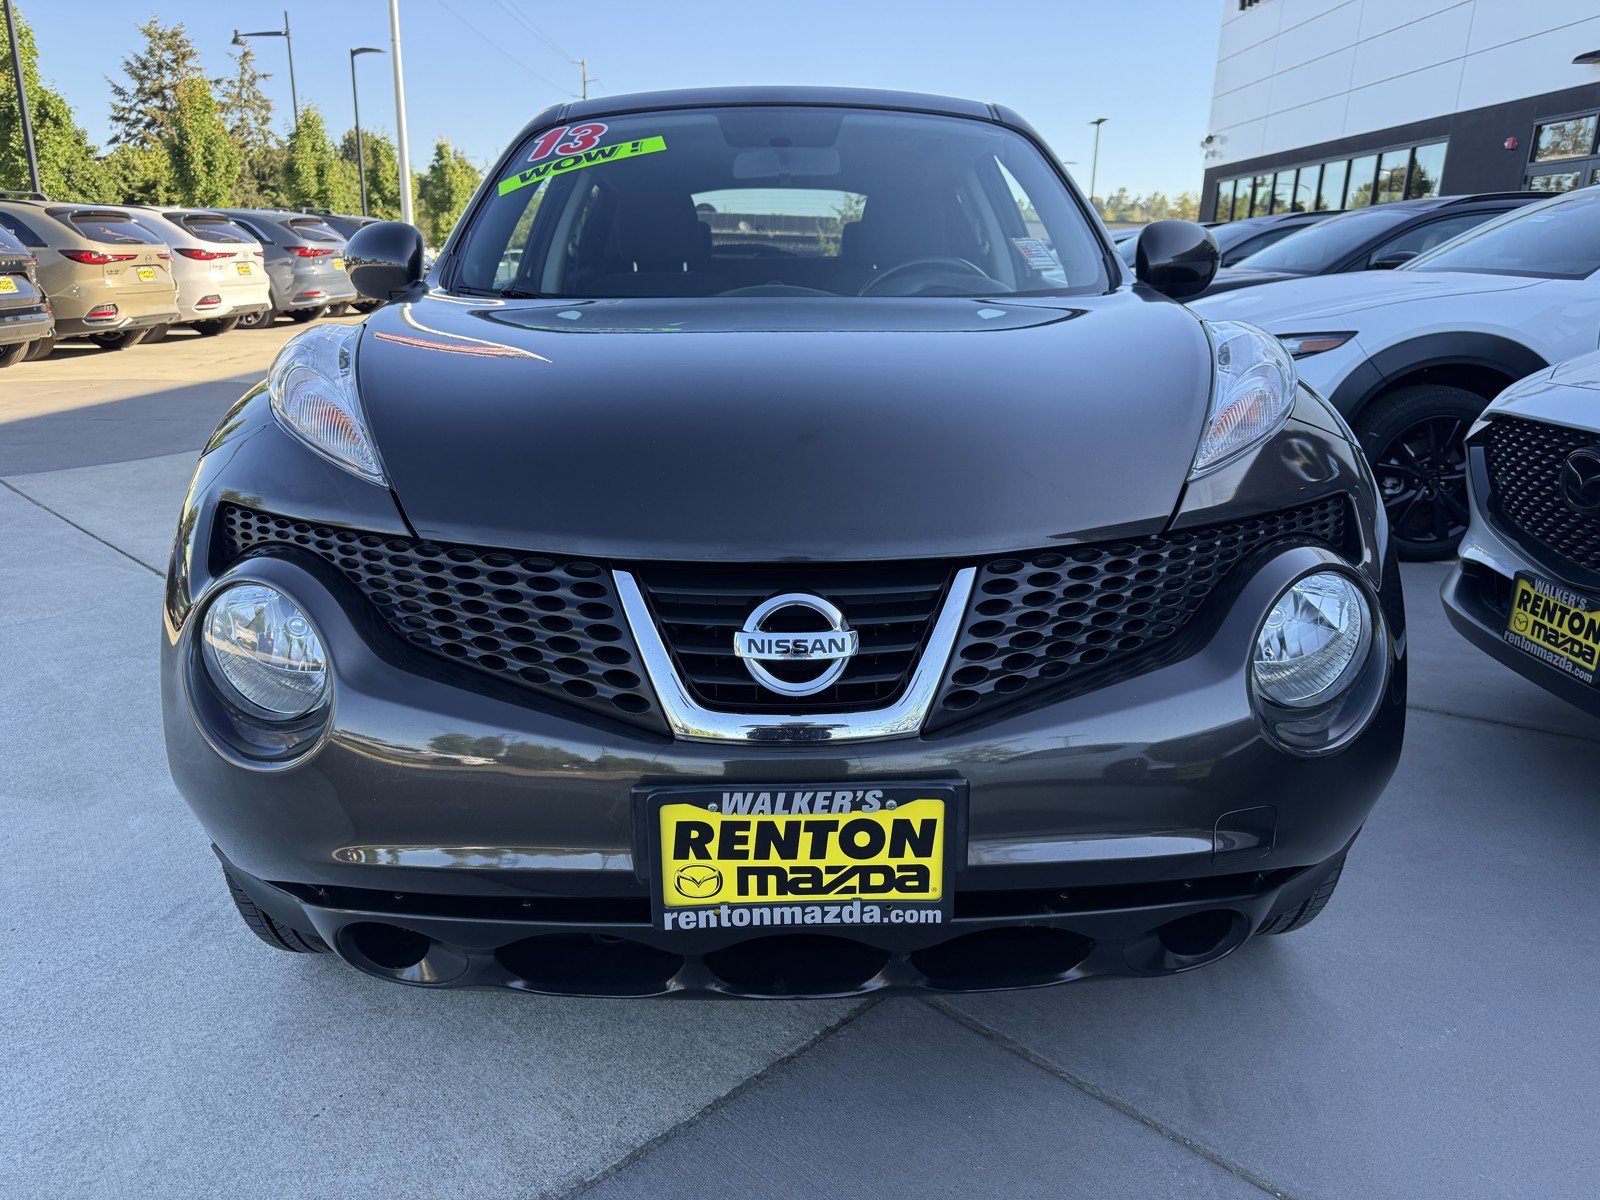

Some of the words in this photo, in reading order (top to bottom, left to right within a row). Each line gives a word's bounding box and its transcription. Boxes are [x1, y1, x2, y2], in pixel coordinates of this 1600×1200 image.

[527, 122, 609, 162] 13
[1535, 579, 1588, 610] WALKER'S
[1517, 588, 1600, 645] RENTON
[748, 638, 846, 654] NISSAN
[1504, 630, 1593, 683] rentonmazda.com
[722, 790, 884, 815] WALKER'S
[673, 818, 937, 861] RENTON
[663, 901, 942, 931] rentonmazda.com
